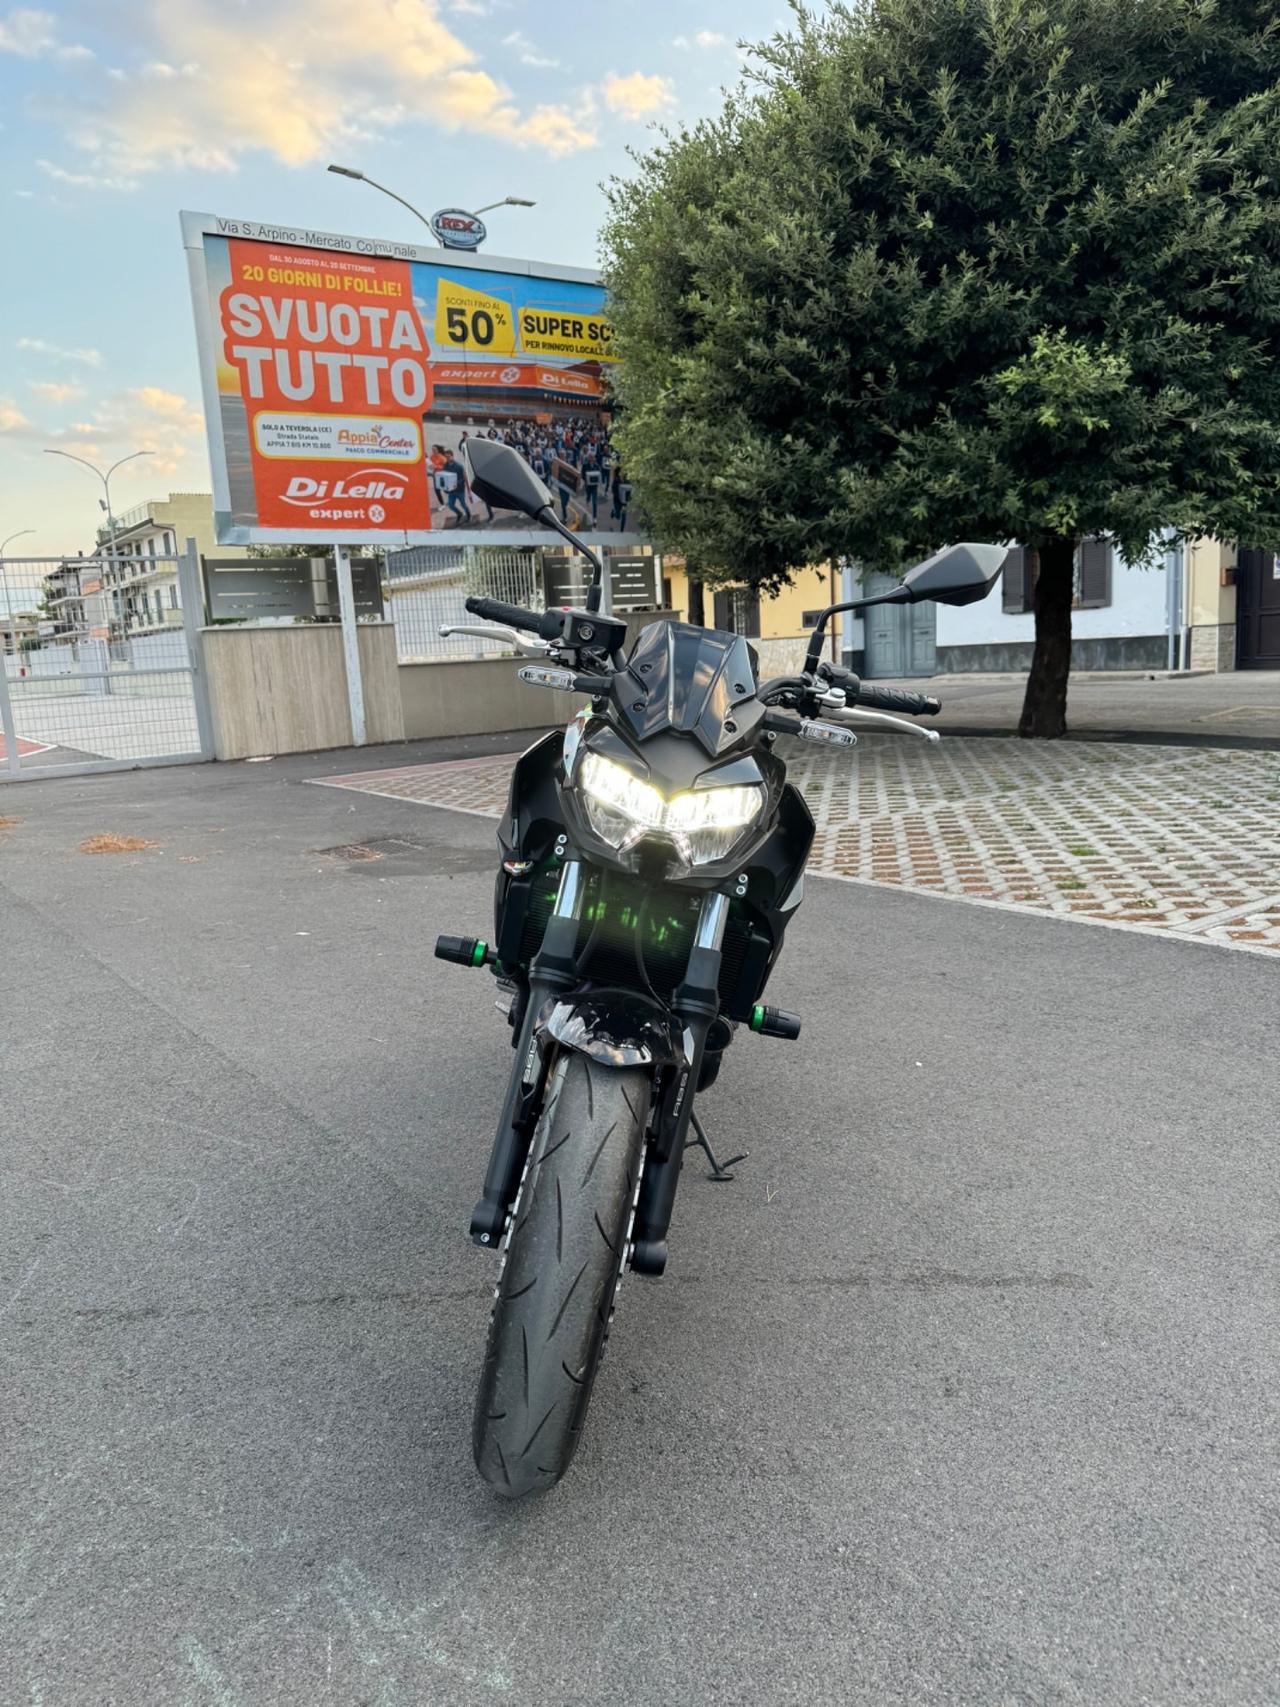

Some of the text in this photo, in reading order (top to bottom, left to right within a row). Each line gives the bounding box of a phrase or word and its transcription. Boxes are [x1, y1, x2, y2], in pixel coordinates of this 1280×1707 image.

[218, 220, 239, 233] Via
[242, 224, 255, 237] S.
[258, 226, 297, 242] Arpino
[356, 239, 417, 258] Comunale
[242, 264, 402, 297] 20 GIORNI DI FOLLIE!
[228, 293, 423, 351] SVUOTA
[523, 315, 584, 339] SUPER
[526, 340, 540, 349] PER
[542, 342, 575, 353] RINNOVO
[232, 345, 427, 408] TUTTO
[440, 369, 497, 379] expert
[542, 373, 560, 385] Di
[338, 429, 415, 449] Appia Center
[286, 477, 404, 499] Di Lella
[309, 507, 365, 520] expert
